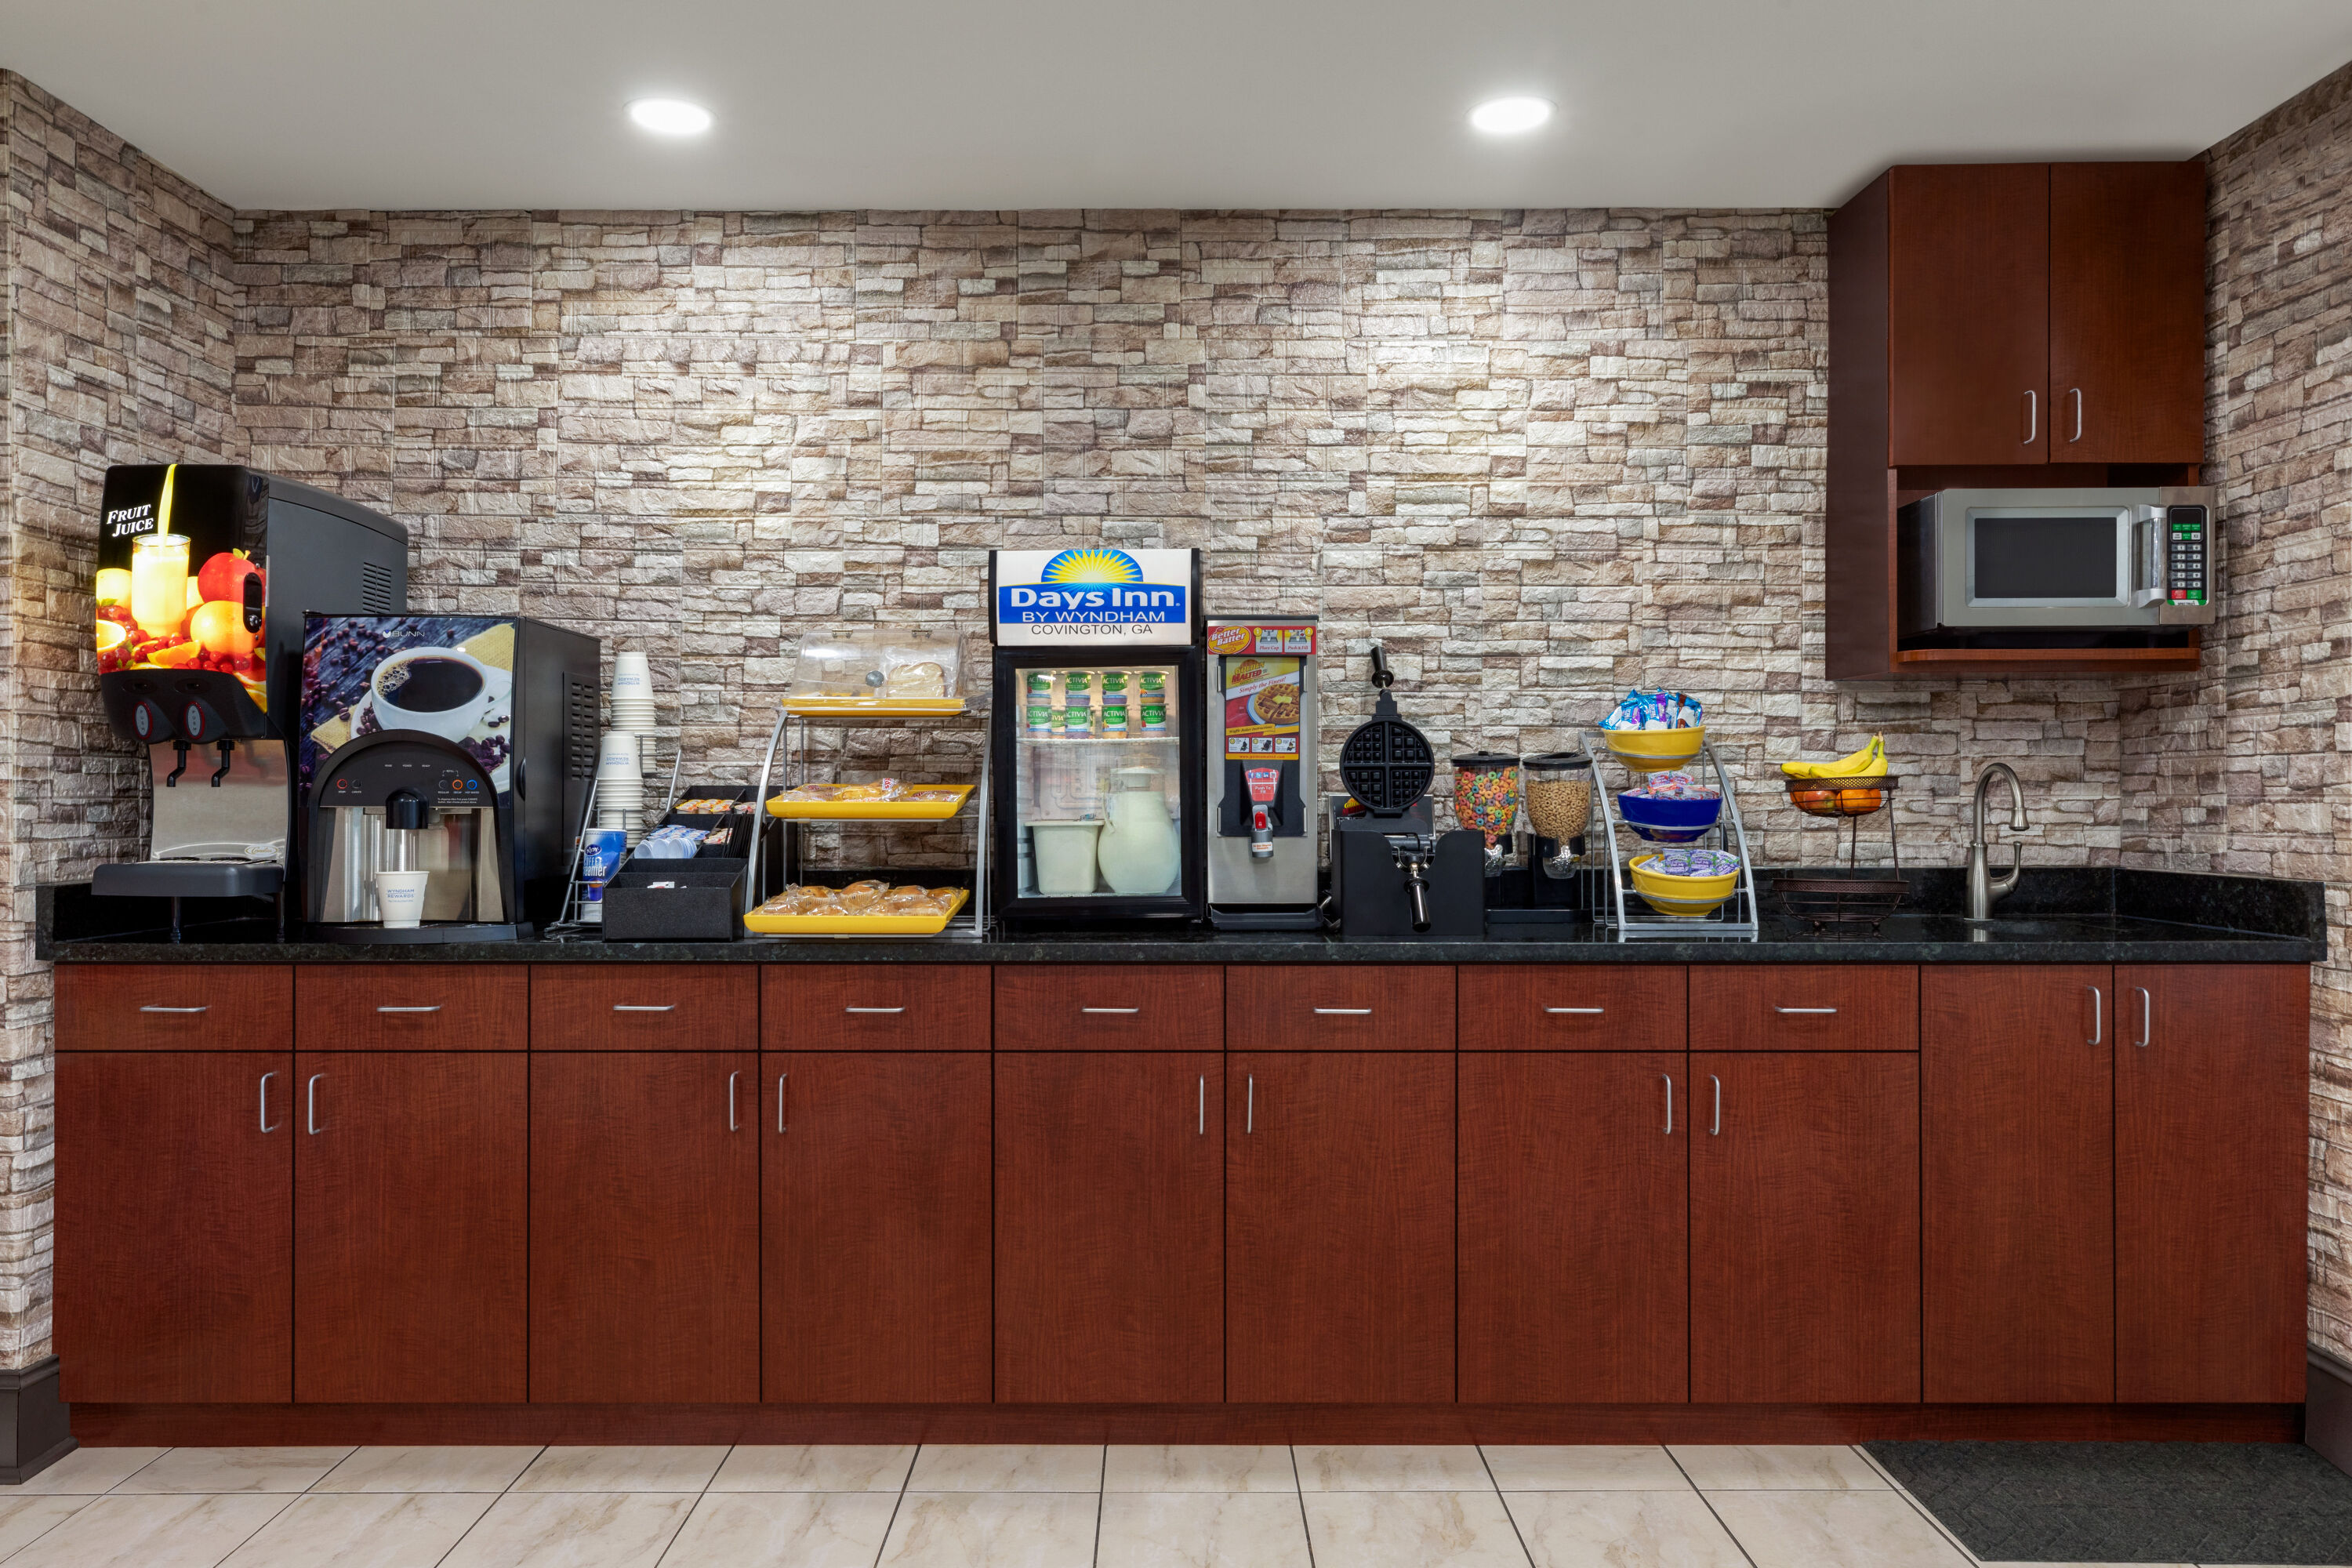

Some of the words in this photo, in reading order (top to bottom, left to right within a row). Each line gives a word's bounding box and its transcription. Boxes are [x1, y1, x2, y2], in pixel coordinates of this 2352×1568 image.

[107, 504, 151, 524] FRUIT
[112, 517, 154, 537] JUICE
[1011, 588, 1104, 609] Days
[1112, 588, 1174, 607] Inn
[1022, 612, 1049, 622] BY
[1055, 612, 1165, 622] WYNDHAM
[1031, 625, 1127, 636] COVINGTON,
[1131, 625, 1152, 634] GA
[1211, 628, 1240, 641] Better
[1217, 633, 1245, 646] Batter
[1235, 661, 1265, 675] GOLDEN
[1232, 669, 1262, 683] MALTED
[1240, 684, 1258, 693] Simply
[1268, 677, 1287, 685] Finest!
